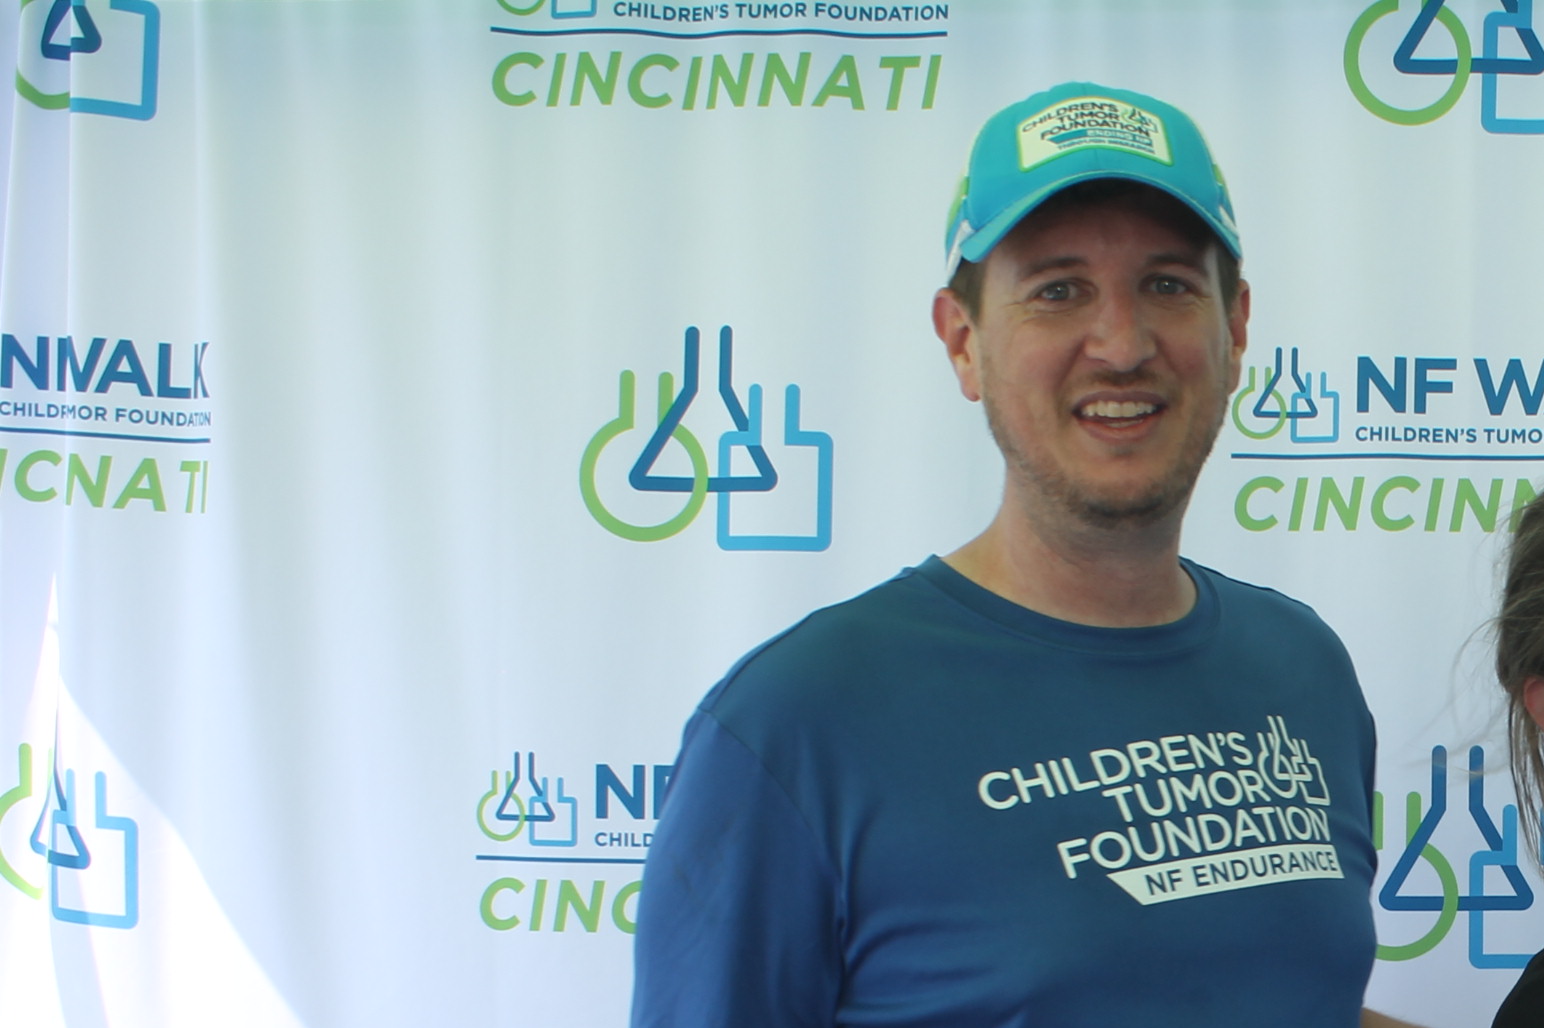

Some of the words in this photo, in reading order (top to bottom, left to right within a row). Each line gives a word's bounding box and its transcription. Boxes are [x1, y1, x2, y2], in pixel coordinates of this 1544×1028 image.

[613, 1, 730, 23] CHILDREN'S
[735, 2, 807, 20] TUMOR
[814, 2, 950, 22] FOUNDATION
[491, 51, 943, 111] CINCINNATI
[1022, 102, 1120, 133] CHILDREN'S
[1040, 119, 1151, 141] FOUNDATION
[1058, 110, 1120, 124] TUMOR
[1356, 356, 1458, 414] NF
[1355, 426, 1478, 444] CHILDREN'S
[978, 732, 1254, 810] CHILDREN'S
[1102, 769, 1271, 822] TUMOR
[1056, 806, 1331, 880] FOUNDATION
[1145, 868, 1184, 896] NF
[1194, 850, 1337, 887] ENDURANCE
